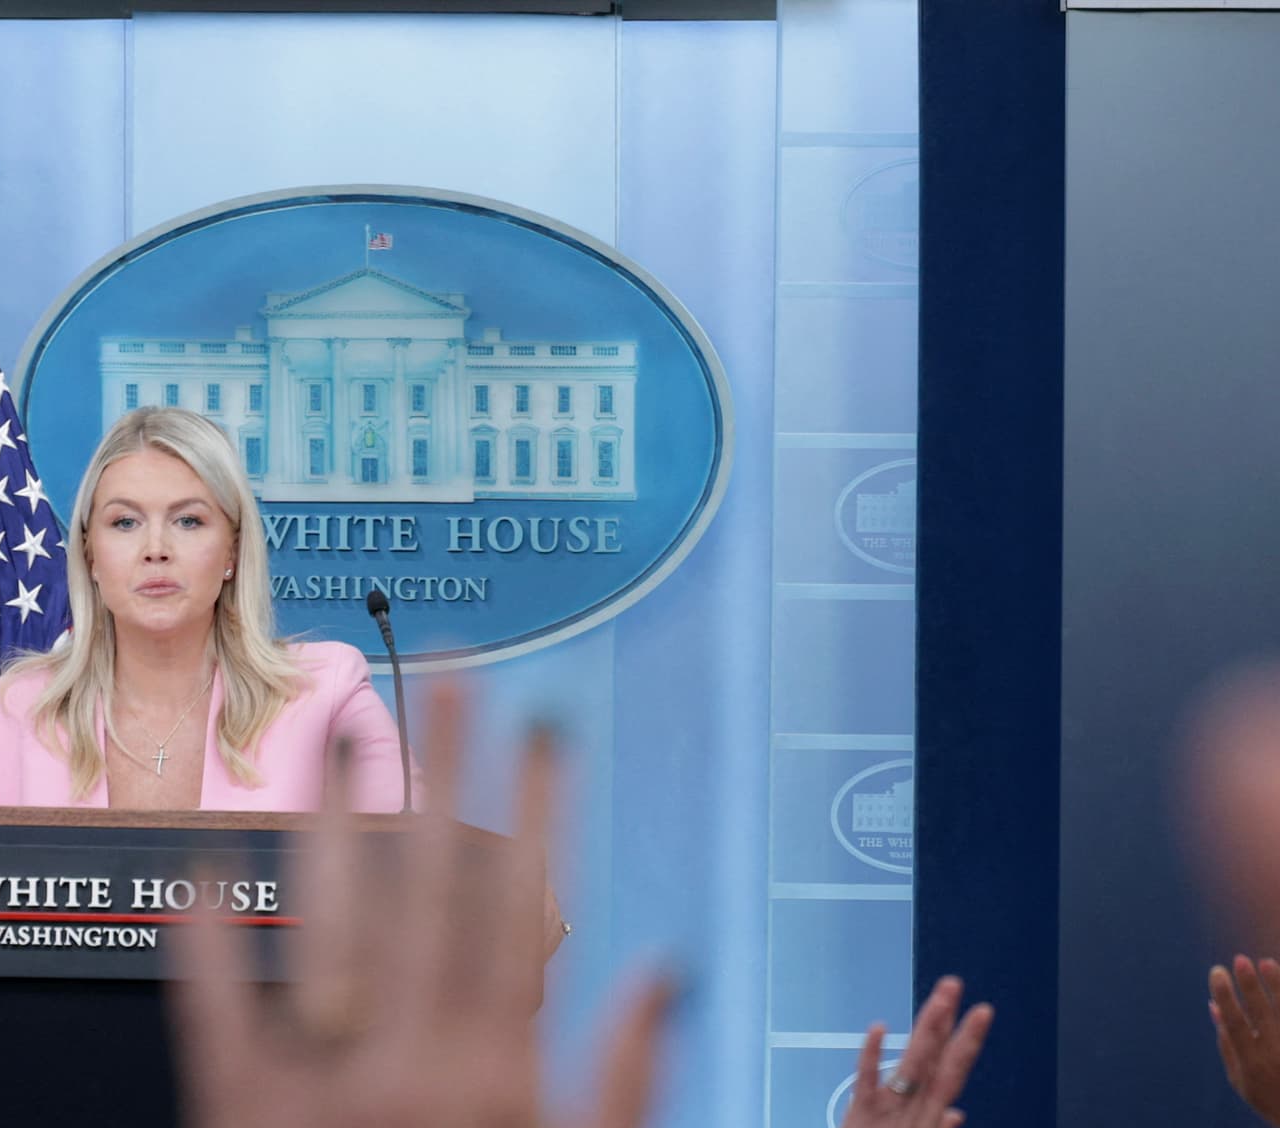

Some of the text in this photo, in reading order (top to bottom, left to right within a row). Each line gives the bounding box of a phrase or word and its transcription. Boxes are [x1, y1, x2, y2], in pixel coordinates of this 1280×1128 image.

[261, 514, 623, 553] WHITE HOUSE
[858, 836, 884, 848] THE
[131, 878, 280, 912] HOUSE
